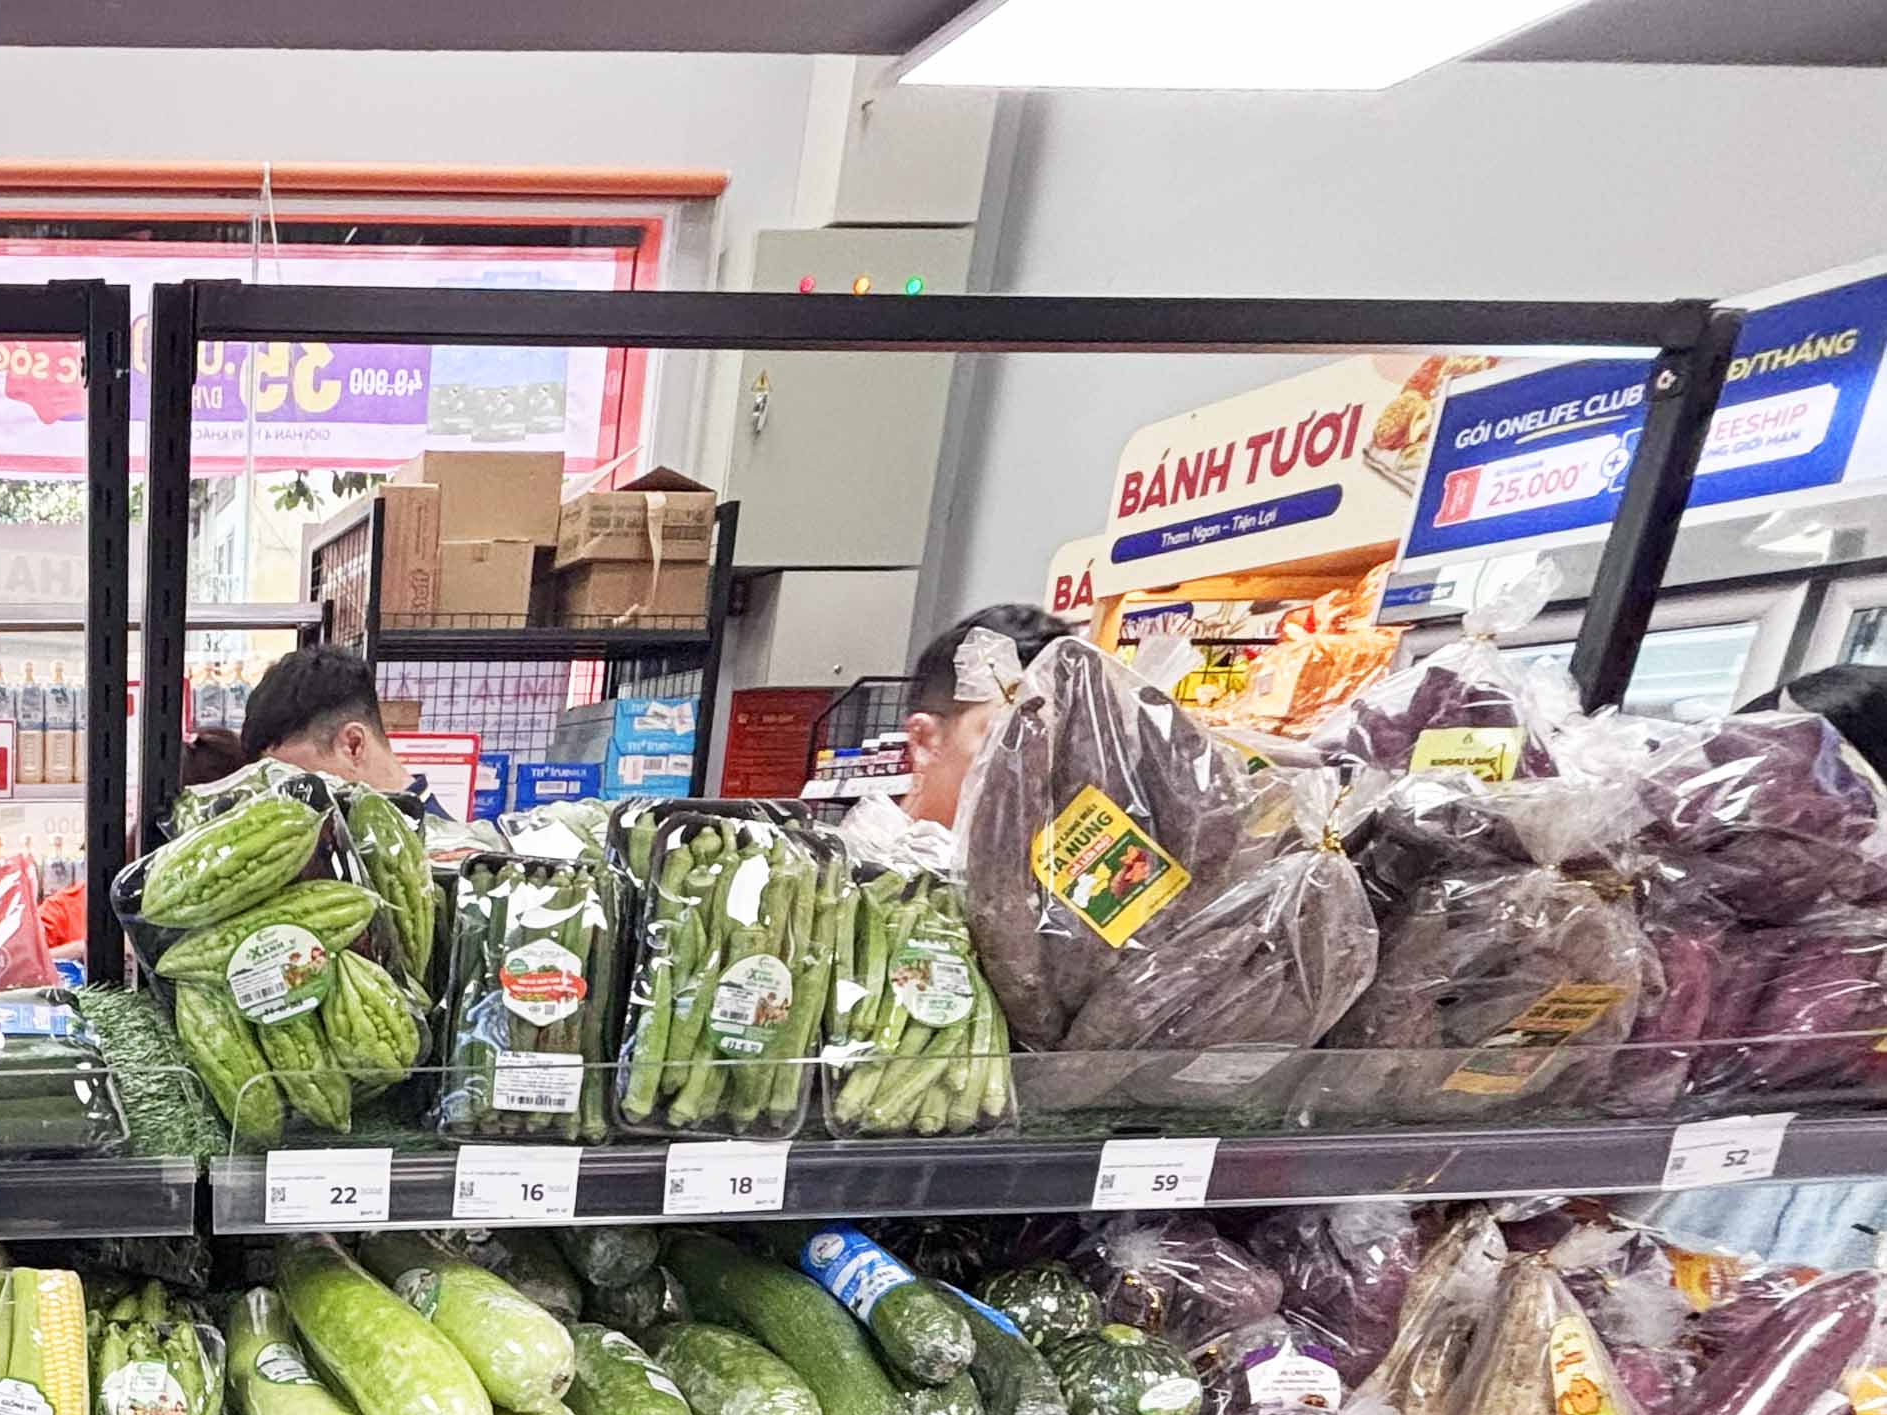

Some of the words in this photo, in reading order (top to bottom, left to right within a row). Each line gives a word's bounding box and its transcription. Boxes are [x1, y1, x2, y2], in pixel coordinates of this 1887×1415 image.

[1455, 421, 1490, 450] GÓI
[1495, 400, 1582, 437] ONELIFE
[1583, 384, 1646, 417] CLUB
[1707, 403, 1809, 442] EESHIP
[1117, 441, 1237, 520] BÁNH
[1244, 402, 1365, 485] TƯƠI
[1065, 810, 1114, 858] NUNG
[1721, 1149, 1750, 1168] 52
[729, 1177, 753, 1195] 18
[1151, 1174, 1180, 1192] 59
[329, 1187, 358, 1205] 22
[520, 1184, 544, 1202] 16
